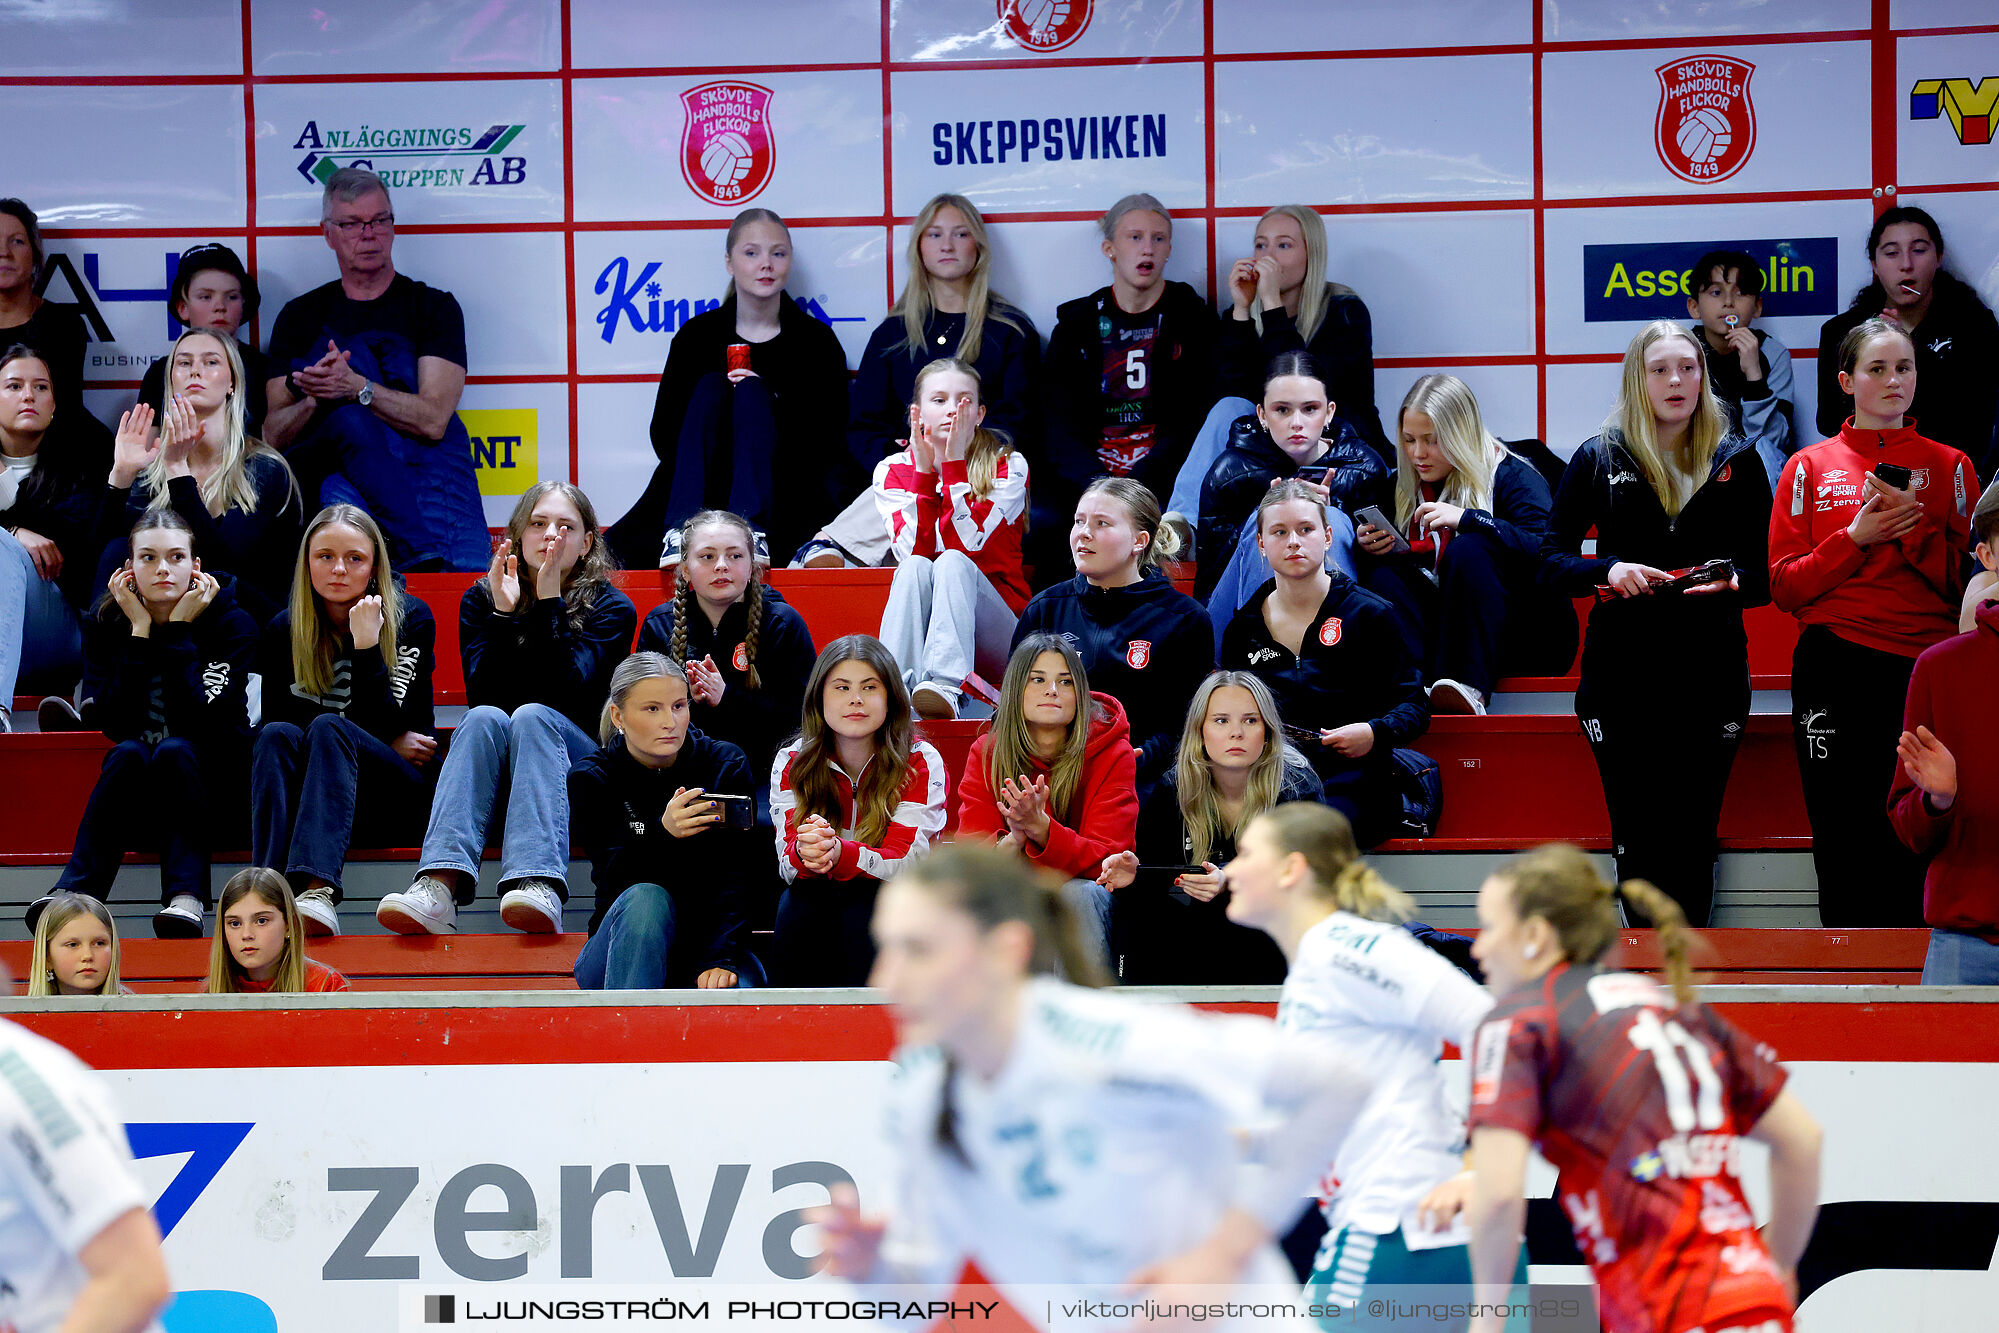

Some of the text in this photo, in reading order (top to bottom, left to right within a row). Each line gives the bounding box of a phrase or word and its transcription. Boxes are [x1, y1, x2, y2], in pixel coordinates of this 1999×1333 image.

[1029, 30, 1058, 45] 1949
[1677, 61, 1733, 80] SKÖVDE
[700, 87, 752, 106] SKÖVDE
[1669, 78, 1740, 99] HANDBOLLS
[1679, 92, 1730, 113] FLICKOR
[693, 103, 761, 124] HANDBOLLS
[293, 120, 472, 149] ANLÄGGNINGS
[703, 117, 751, 138] FLICKOR
[933, 113, 1167, 166] SKEPPSVIKEN
[468, 156, 527, 186] AB
[1689, 162, 1719, 176] 1949
[713, 185, 742, 199] 1949
[1126, 348, 1147, 390] 5
[1832, 484, 1858, 492] INTER
[1833, 499, 1860, 507] zerva
[1806, 735, 1828, 759] TS
[1463, 760, 1476, 768] 152
[1831, 937, 1841, 945] 77
[322, 1160, 861, 1282] zerva
